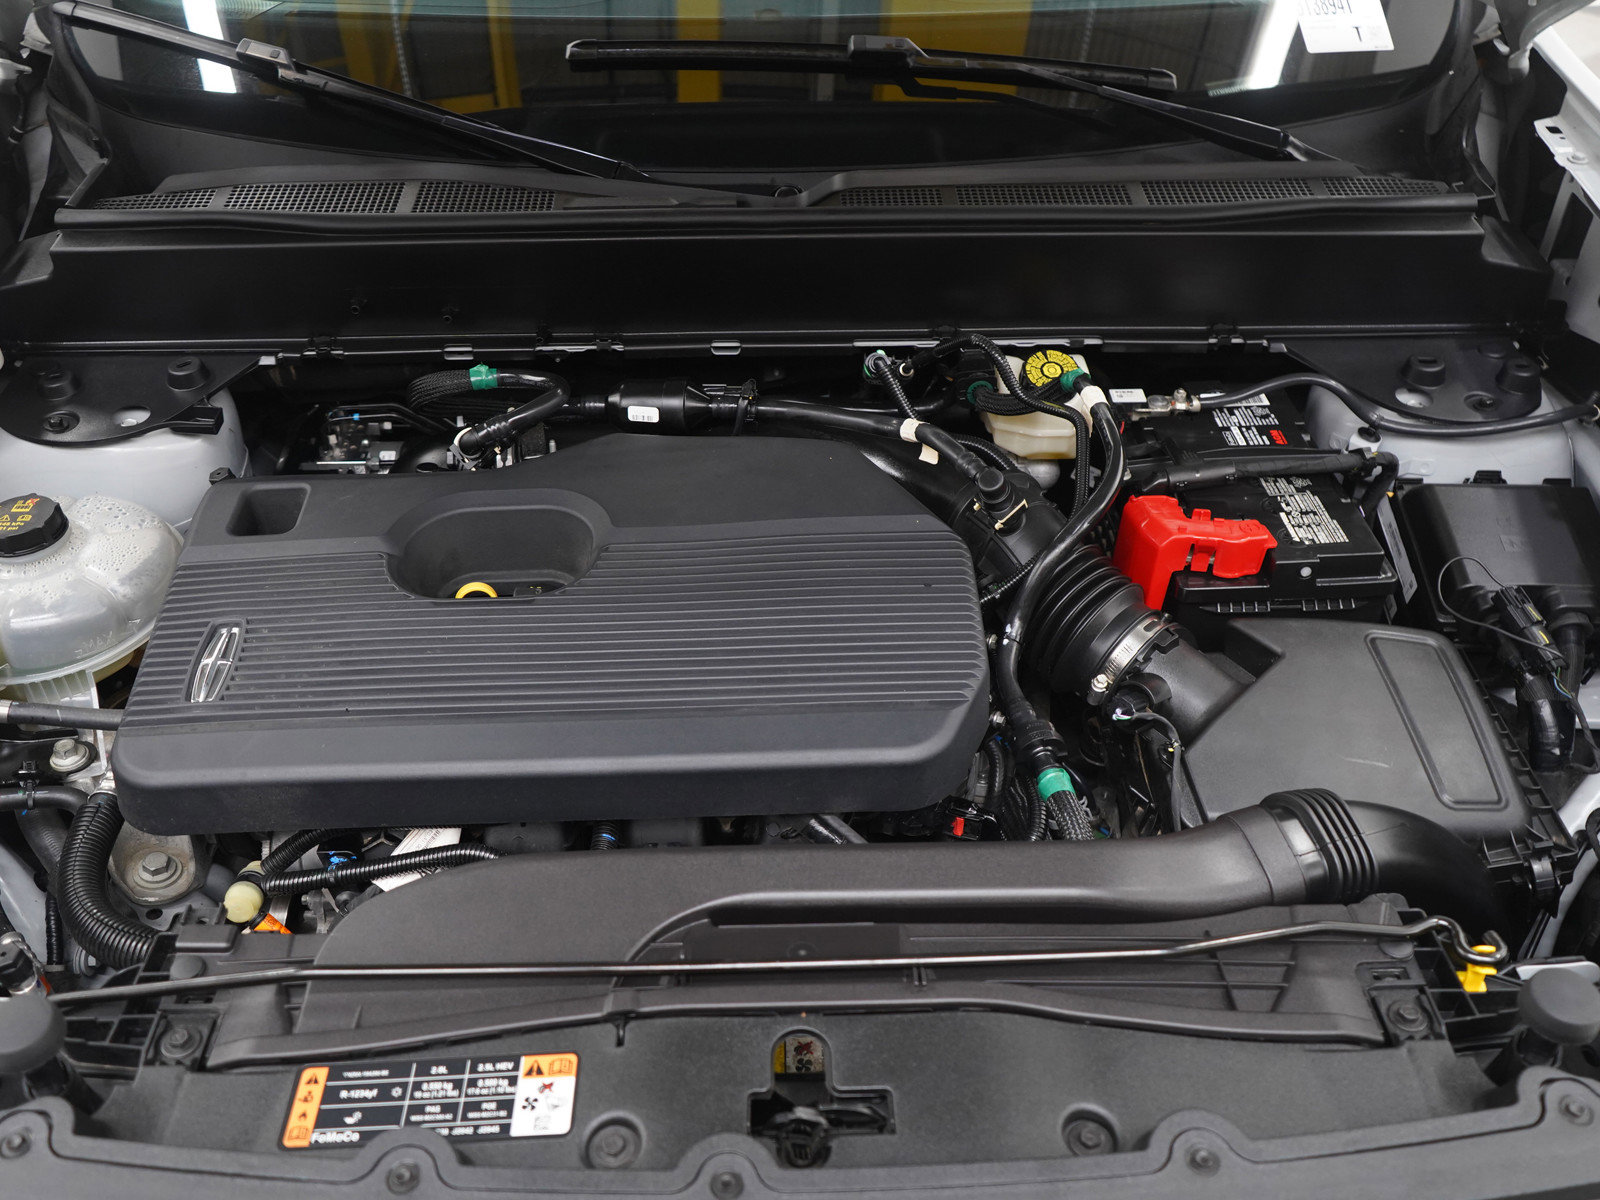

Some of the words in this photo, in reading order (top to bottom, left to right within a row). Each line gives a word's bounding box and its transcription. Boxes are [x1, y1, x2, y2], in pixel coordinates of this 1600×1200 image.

[495, 1061, 514, 1071] HEV
[443, 1081, 454, 1091] kg
[498, 1078, 509, 1087] kg
[339, 1088, 379, 1100] R-1234yf
[310, 1131, 360, 1144] FoMoCo
